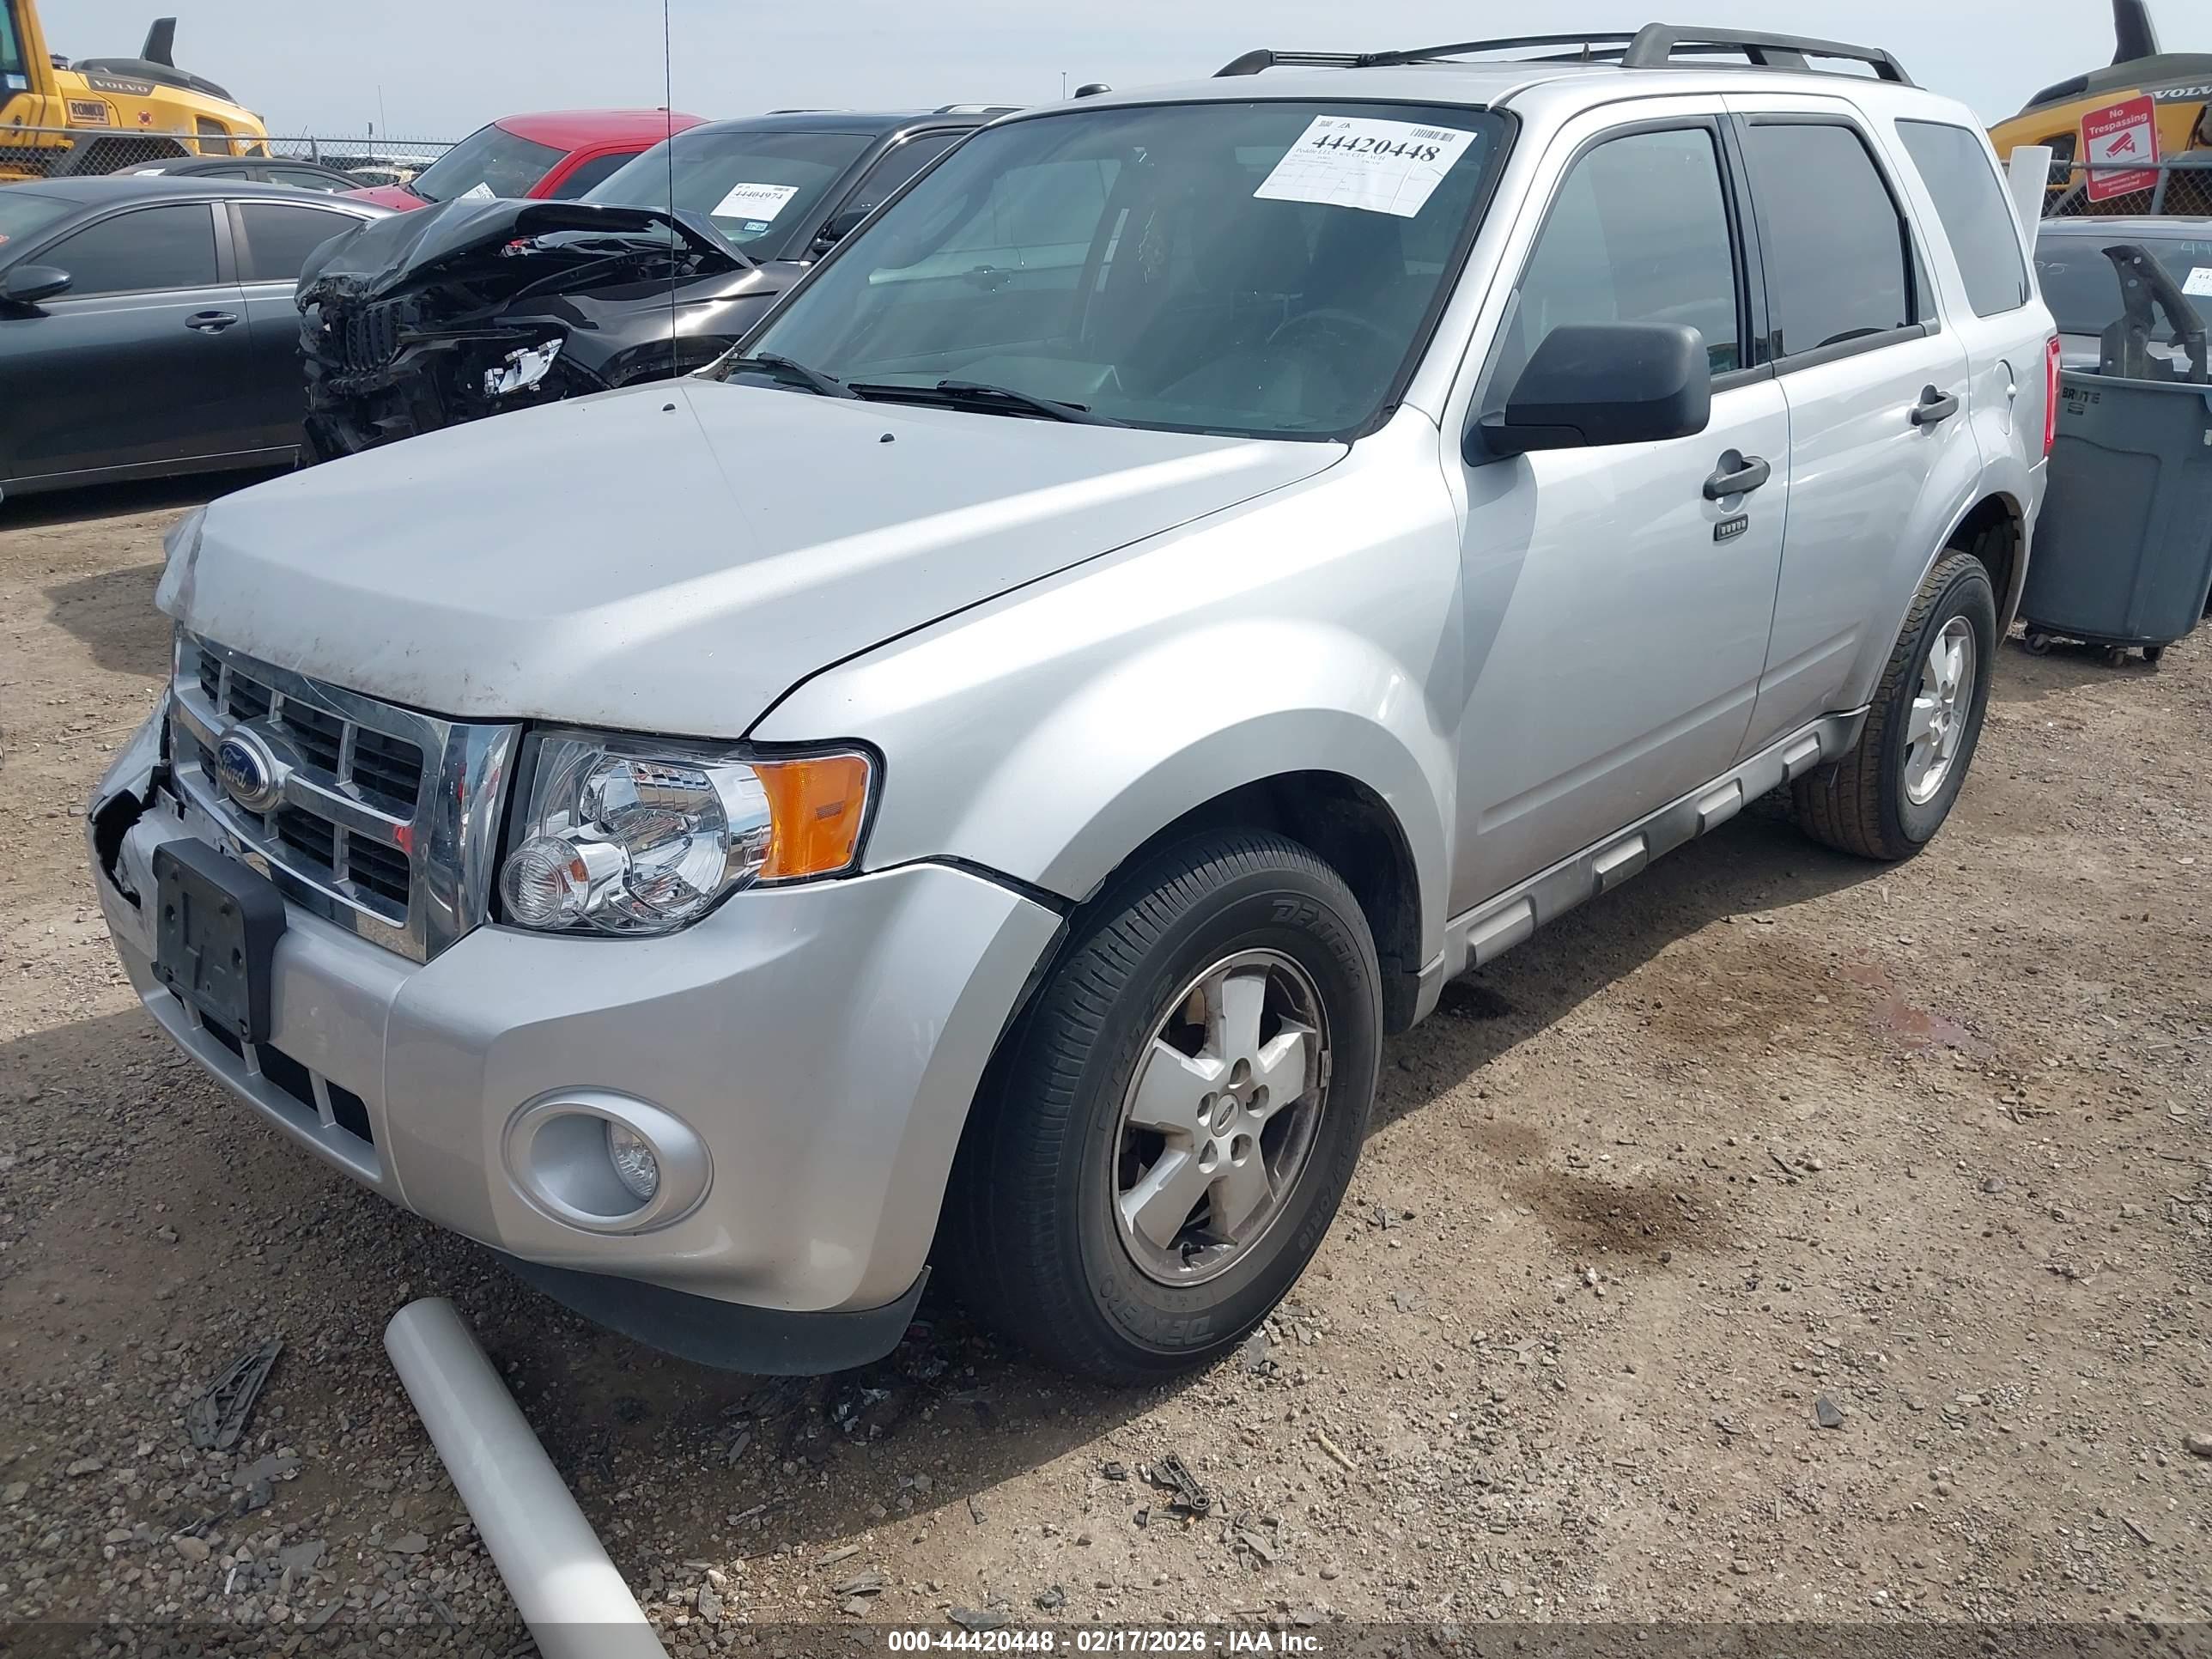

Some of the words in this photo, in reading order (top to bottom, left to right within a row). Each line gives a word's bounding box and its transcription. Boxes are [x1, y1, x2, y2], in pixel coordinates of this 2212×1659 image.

[94, 79, 149, 93] VOLVO
[2109, 109, 2124, 118] No
[2088, 112, 2148, 136] Trespassing
[1311, 134, 1441, 162] 44420448
[734, 191, 783, 199] 44404974
[2062, 386, 2101, 404] BRUTE
[221, 746, 248, 789] Ford
